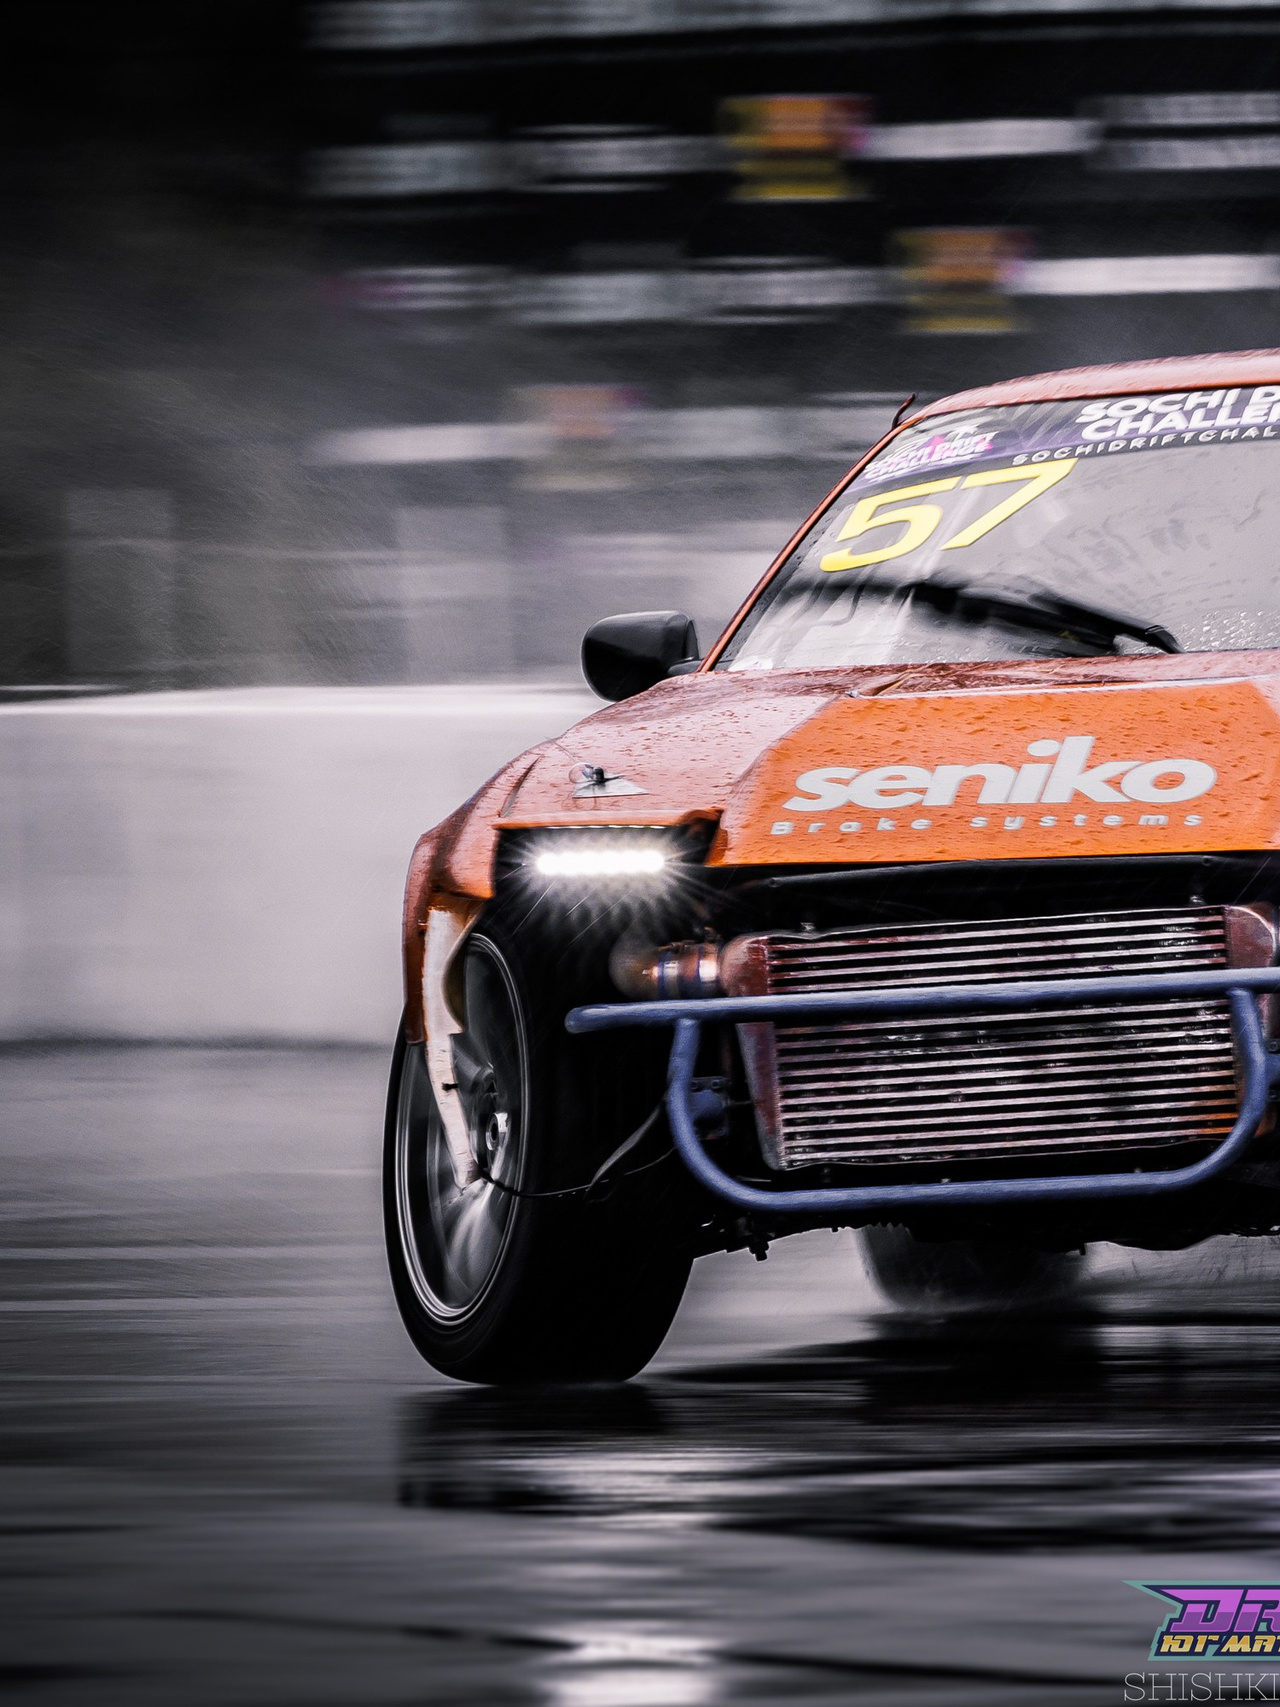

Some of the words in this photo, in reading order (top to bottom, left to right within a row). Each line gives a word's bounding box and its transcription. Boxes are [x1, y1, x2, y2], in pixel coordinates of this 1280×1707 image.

[1075, 387, 1241, 424] SOCHI
[819, 457, 1079, 572] 57
[781, 735, 1217, 812] seniko
[770, 817, 931, 835] Brake
[969, 812, 1203, 831] systems
